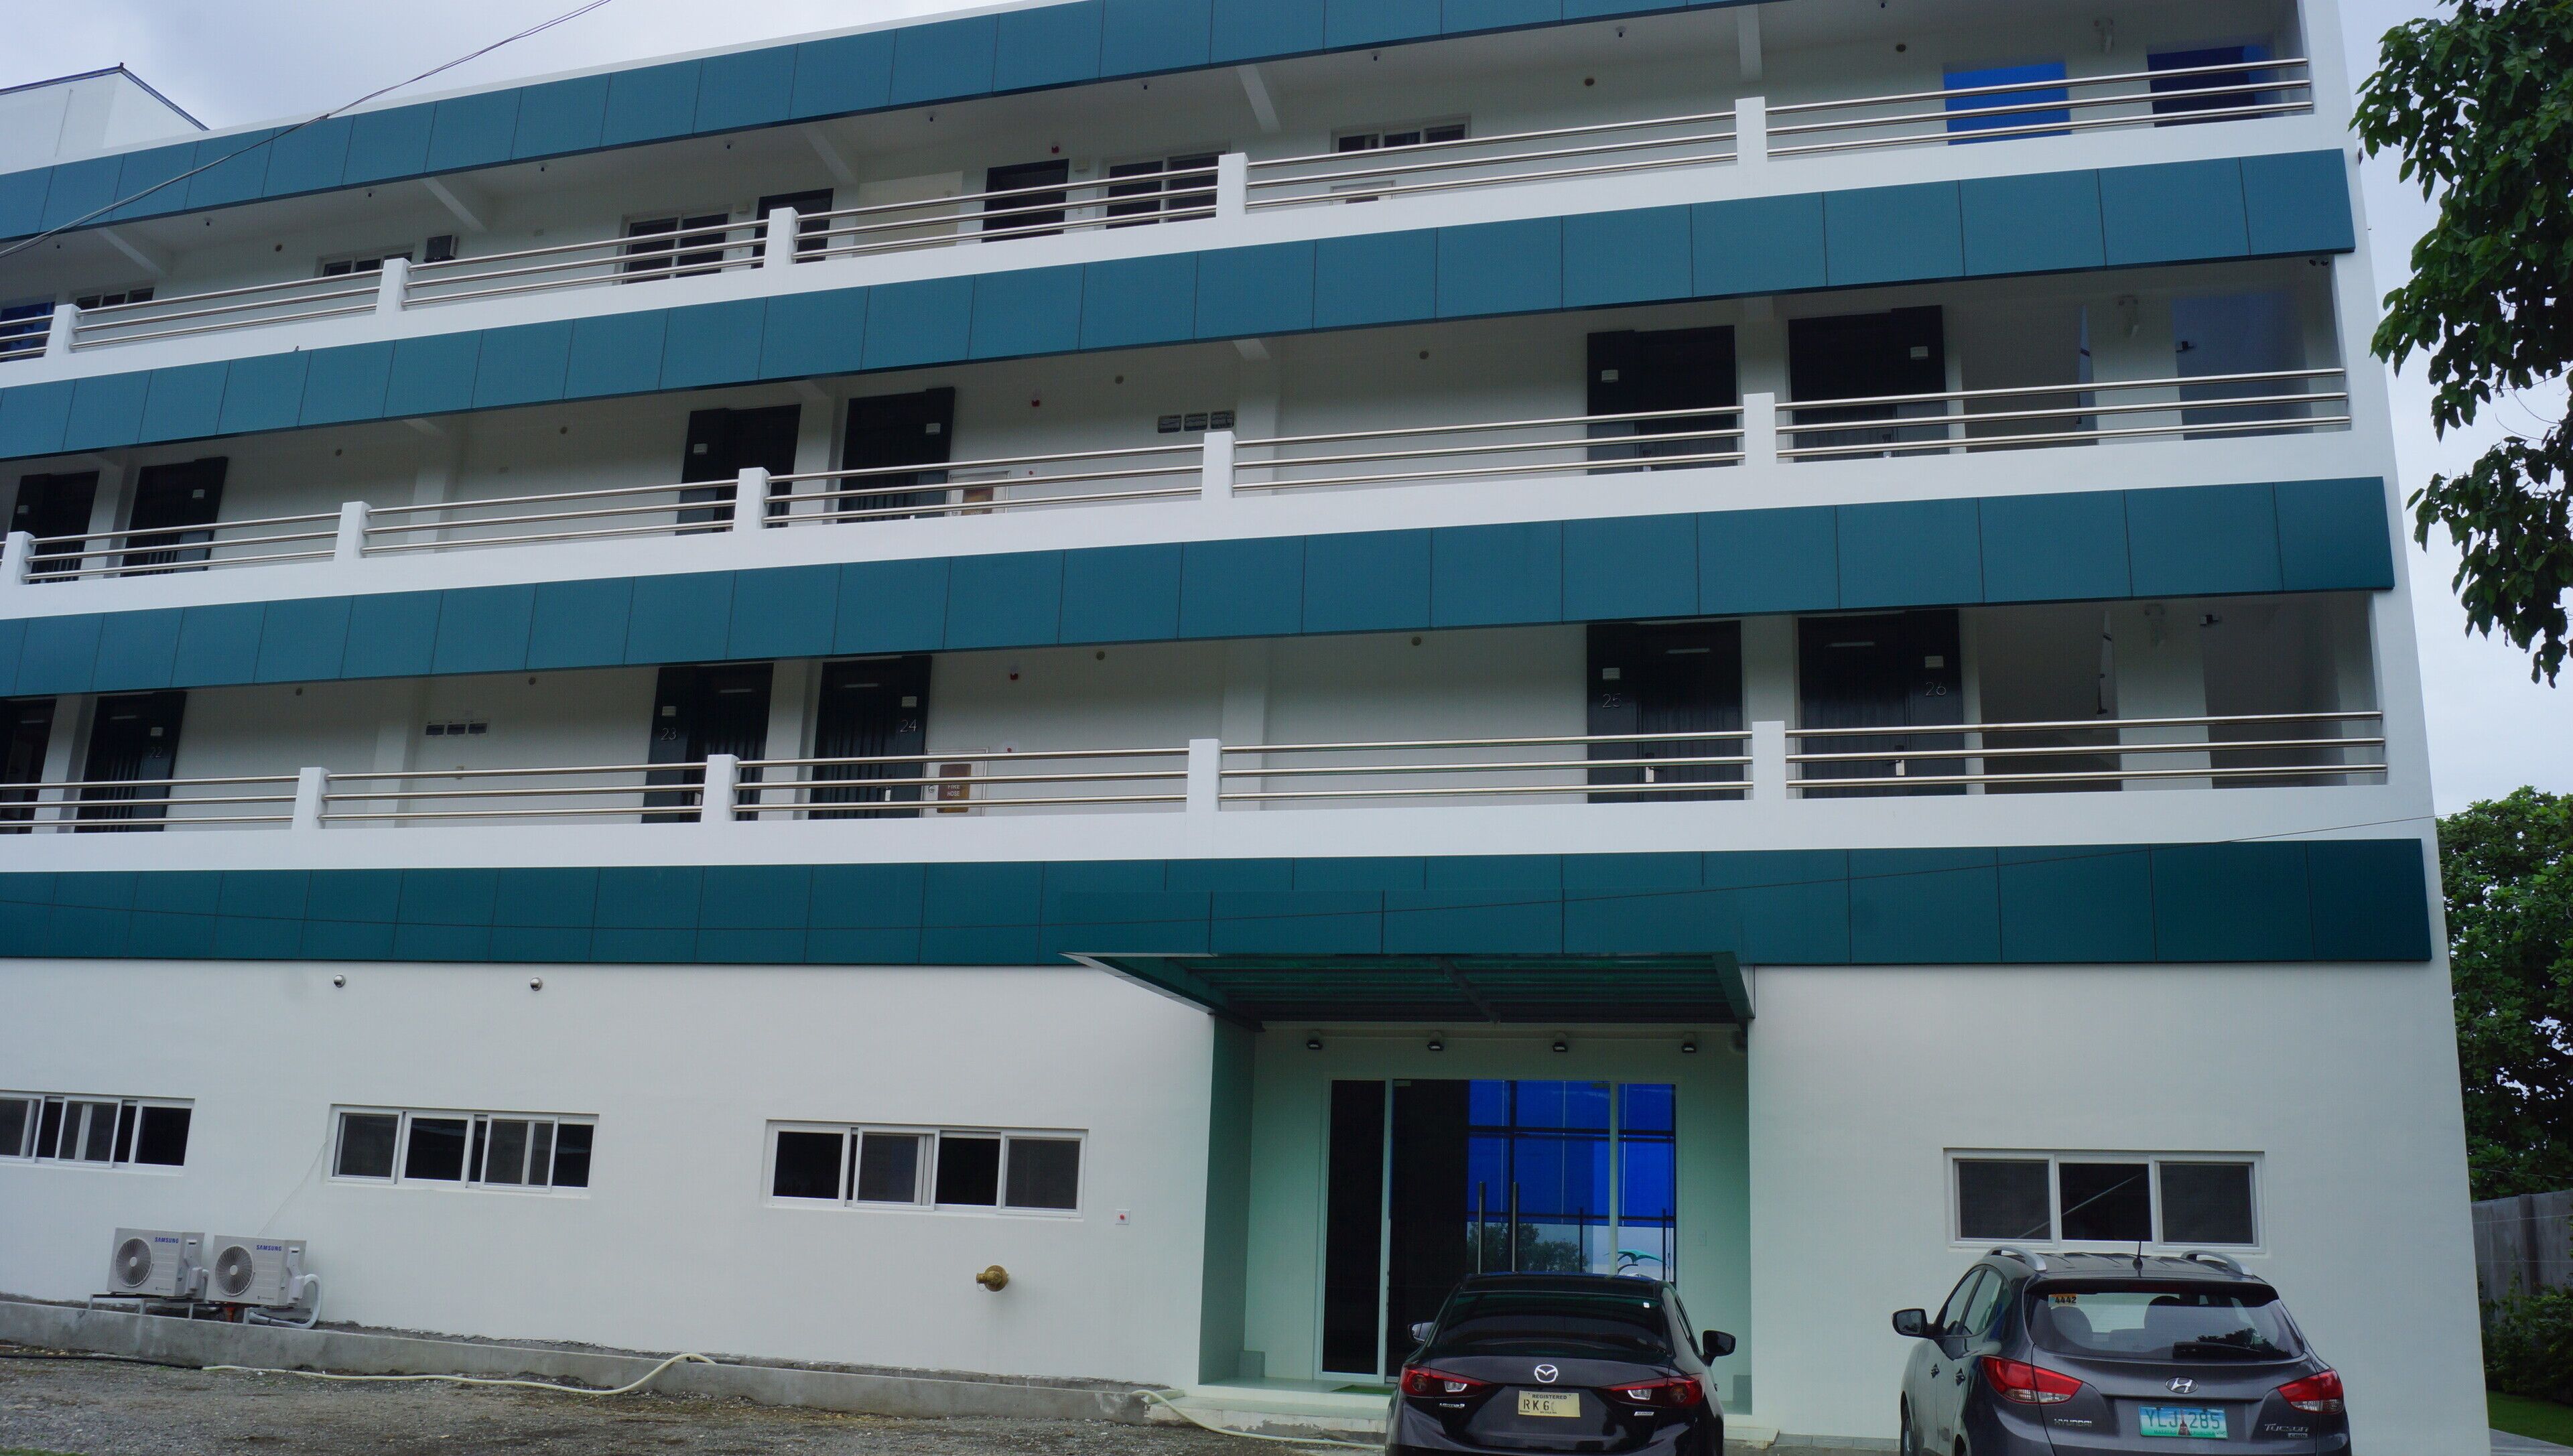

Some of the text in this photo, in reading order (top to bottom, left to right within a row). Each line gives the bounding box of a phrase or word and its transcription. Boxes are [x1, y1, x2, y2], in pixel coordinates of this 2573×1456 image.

[1925, 681, 1947, 696] 26
[1602, 693, 1622, 708] 25
[900, 718, 917, 732] 24
[660, 727, 677, 740] 23
[149, 746, 162, 758] 22
[2054, 1418, 2092, 1427] HYUNDAI
[2145, 1408, 2221, 1429] YLJ 285
